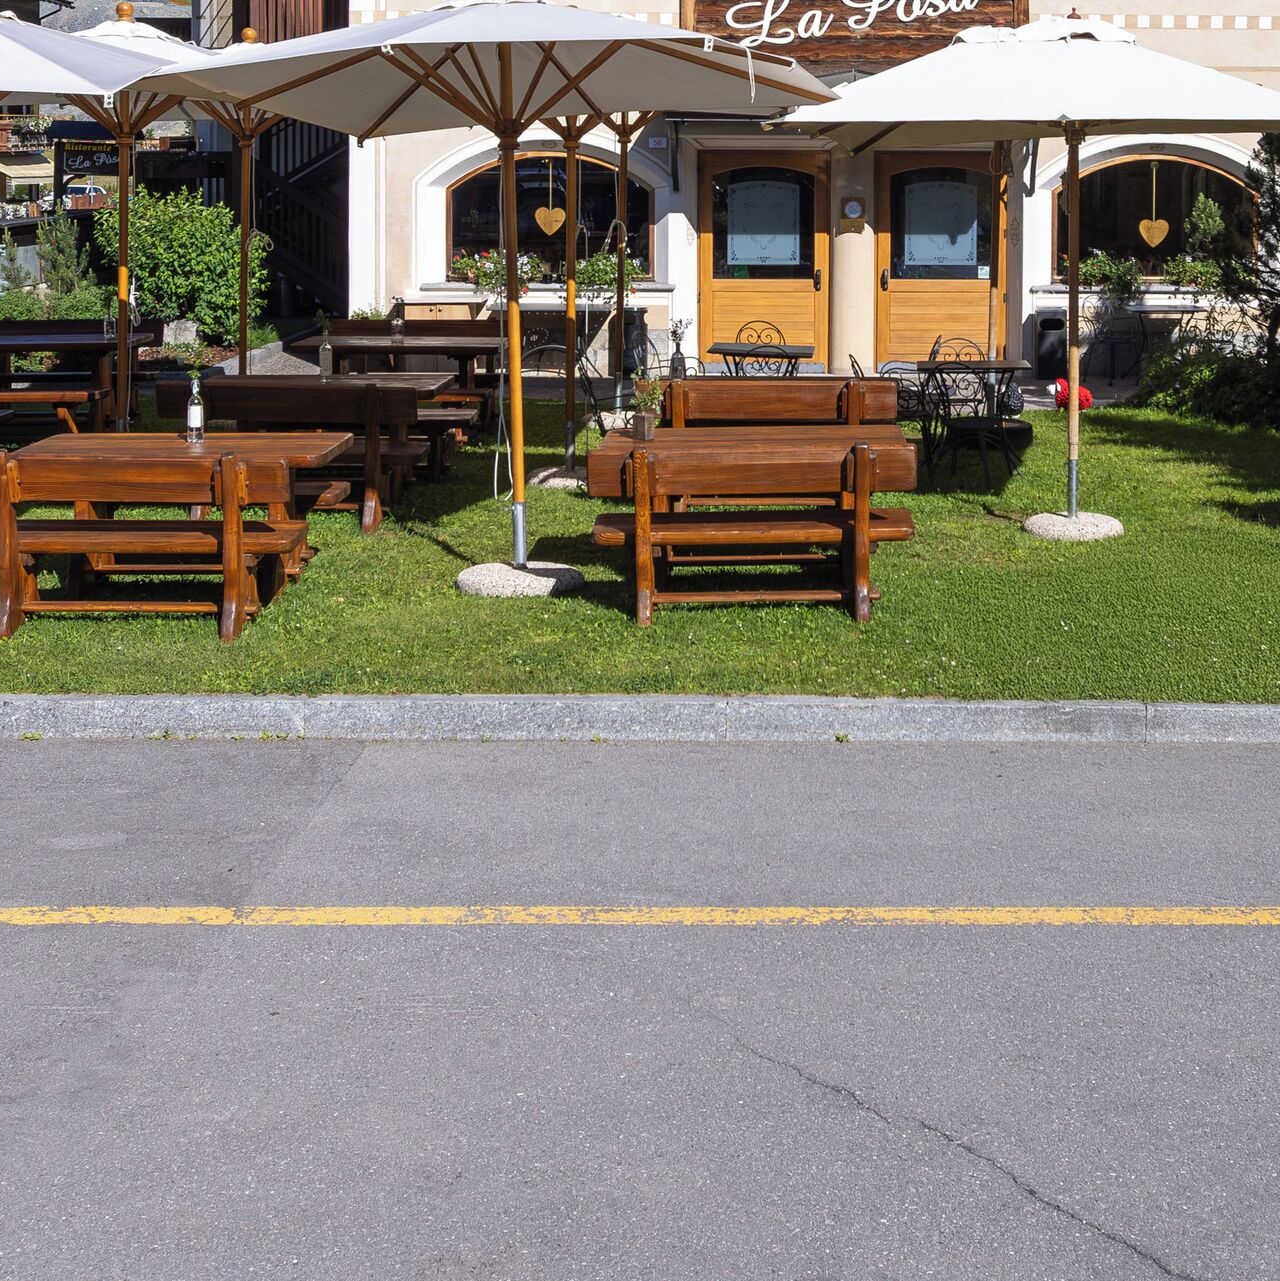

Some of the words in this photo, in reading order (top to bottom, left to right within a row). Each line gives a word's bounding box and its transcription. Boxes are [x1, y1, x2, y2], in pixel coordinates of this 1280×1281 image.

[64, 143, 112, 152] Ristorante
[68, 155, 92, 169] La
[93, 152, 120, 166] Pòs
